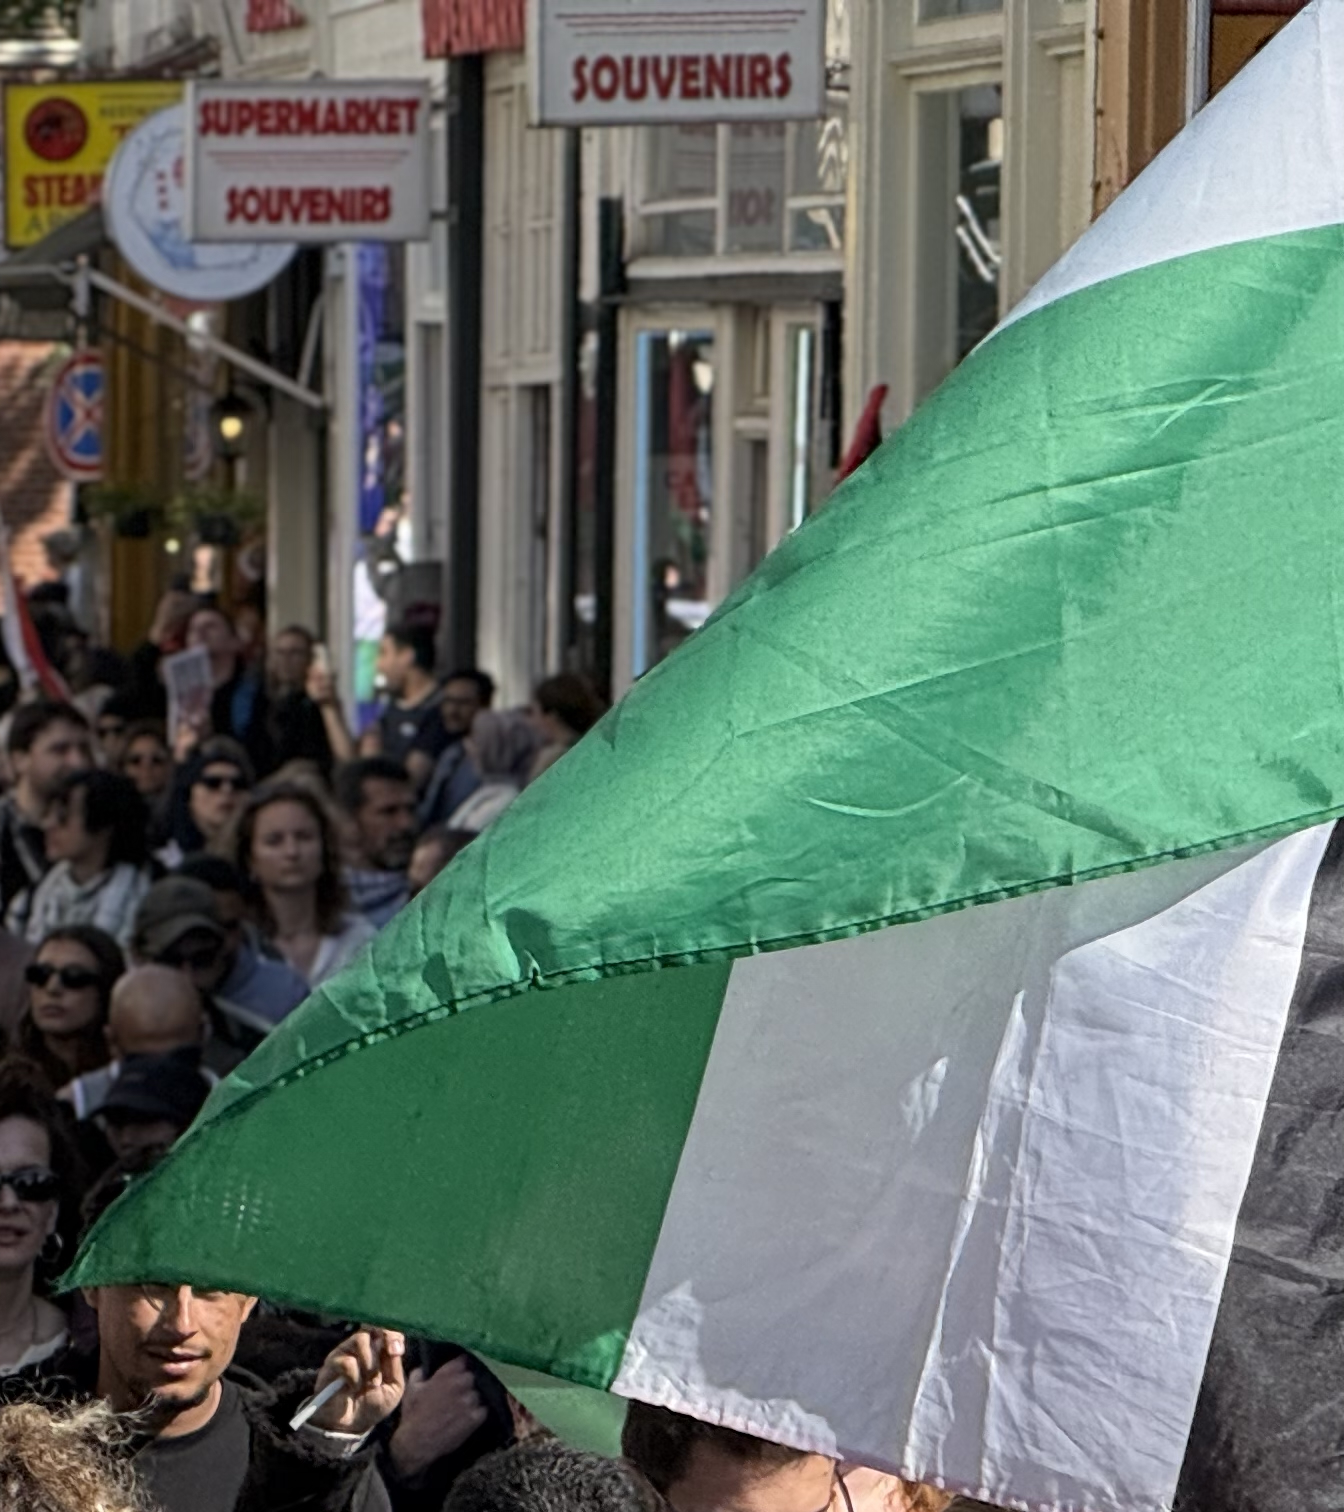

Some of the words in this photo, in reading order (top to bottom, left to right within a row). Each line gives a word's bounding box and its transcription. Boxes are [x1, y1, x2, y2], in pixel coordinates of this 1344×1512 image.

[572, 51, 792, 103] SOUVENIRS
[198, 97, 421, 136] SUPERMARKET
[226, 184, 392, 224] SOUVENIRS
